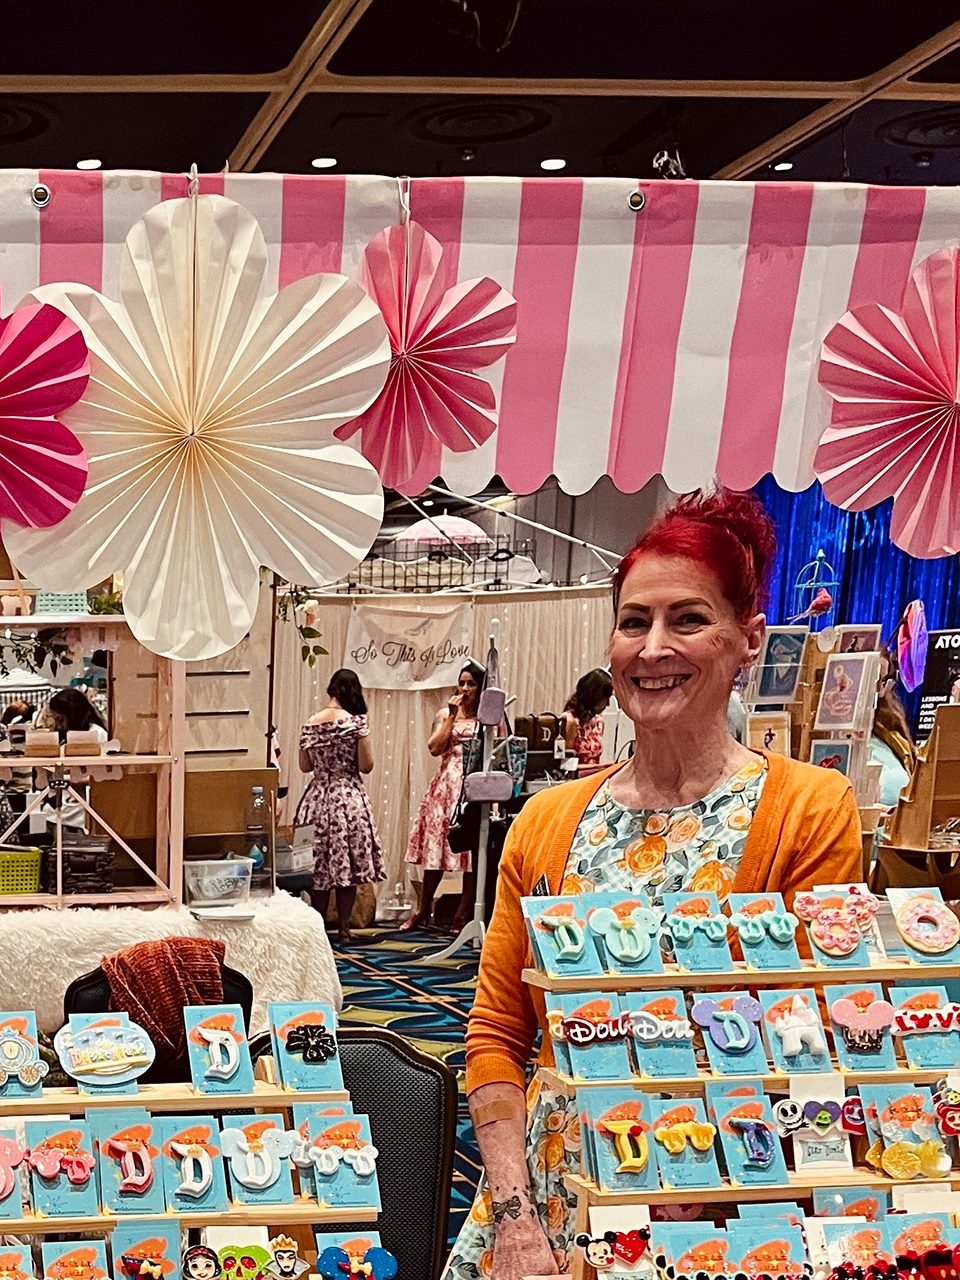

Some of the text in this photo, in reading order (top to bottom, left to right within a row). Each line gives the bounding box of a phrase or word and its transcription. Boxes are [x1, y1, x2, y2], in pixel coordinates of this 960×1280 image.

[351, 639, 469, 667] So This Is Love
